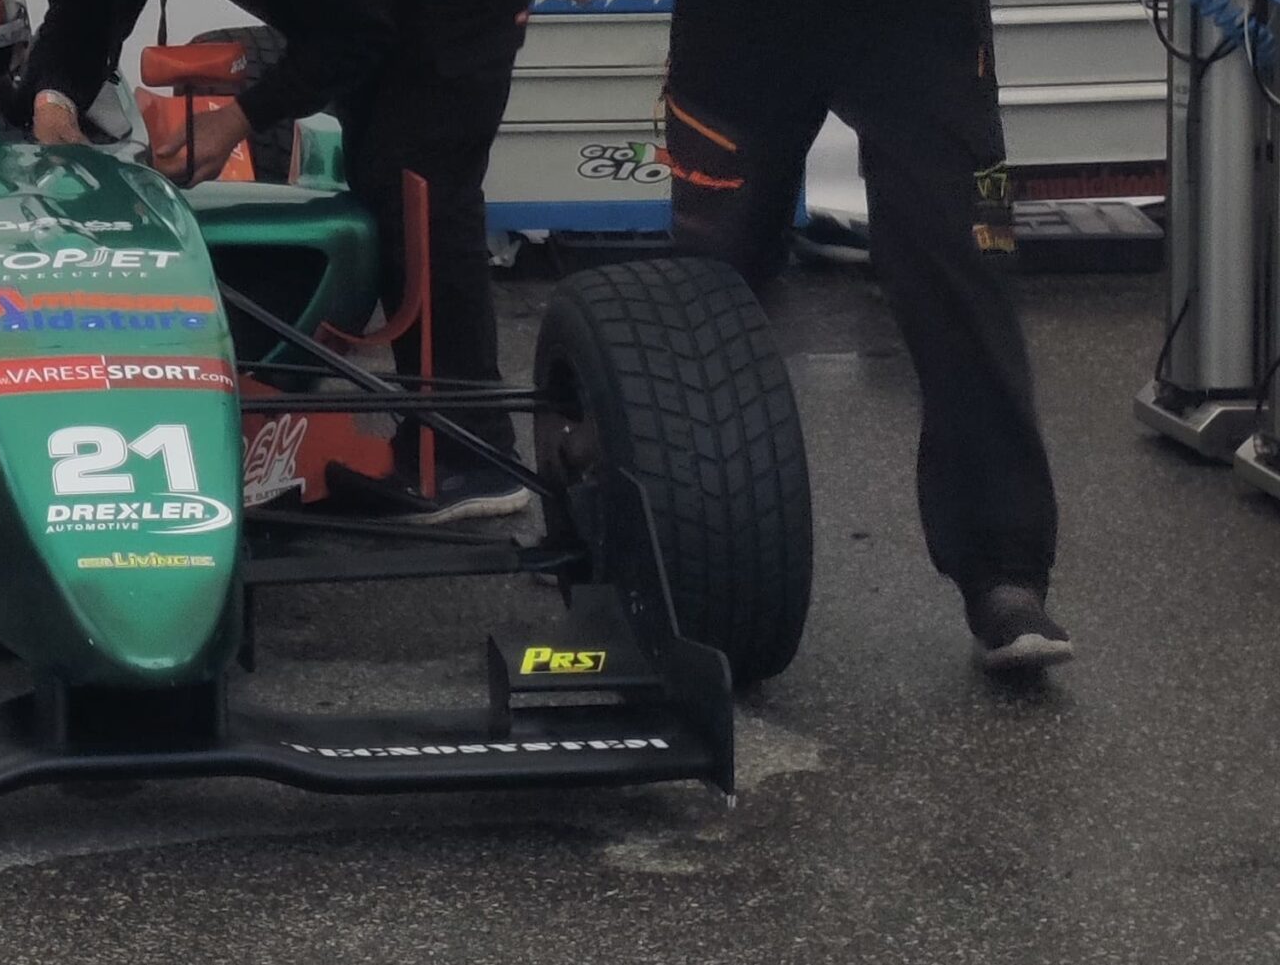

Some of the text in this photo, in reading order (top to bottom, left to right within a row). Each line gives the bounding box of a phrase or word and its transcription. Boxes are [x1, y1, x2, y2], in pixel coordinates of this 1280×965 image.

[578, 157, 672, 184] GIO
[3, 271, 149, 282] EXECUTIVE
[48, 424, 200, 496] 21
[47, 502, 206, 523] DREXLER
[45, 522, 140, 535] AUTOMOTIVE
